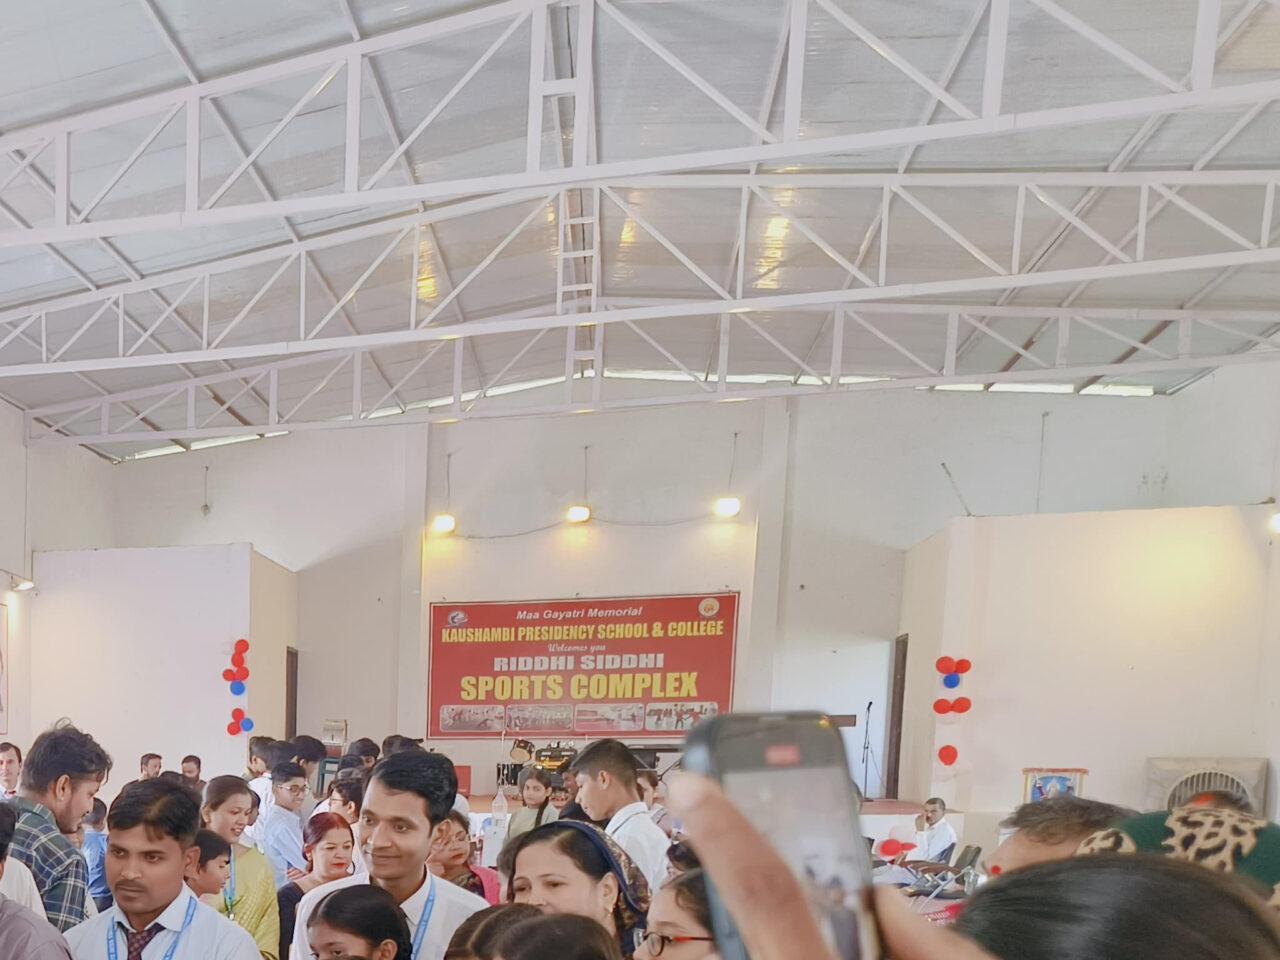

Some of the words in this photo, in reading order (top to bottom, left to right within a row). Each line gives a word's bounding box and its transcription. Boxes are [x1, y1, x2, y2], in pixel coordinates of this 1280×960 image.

[516, 609, 540, 620] Maa
[543, 608, 585, 621] Gayatri
[588, 606, 642, 618] Memorial
[441, 626, 515, 643] KAUSHAMBI
[517, 624, 596, 642] PRESIDENCY
[598, 622, 649, 639] SCHOOL
[652, 621, 664, 638] &
[668, 620, 724, 637] COLLEGE
[590, 644, 606, 653] you
[494, 656, 575, 672] RIDDHI
[580, 653, 664, 669] SIDDHI
[460, 674, 563, 701] SPORTS
[570, 672, 698, 699] COMPLEX
